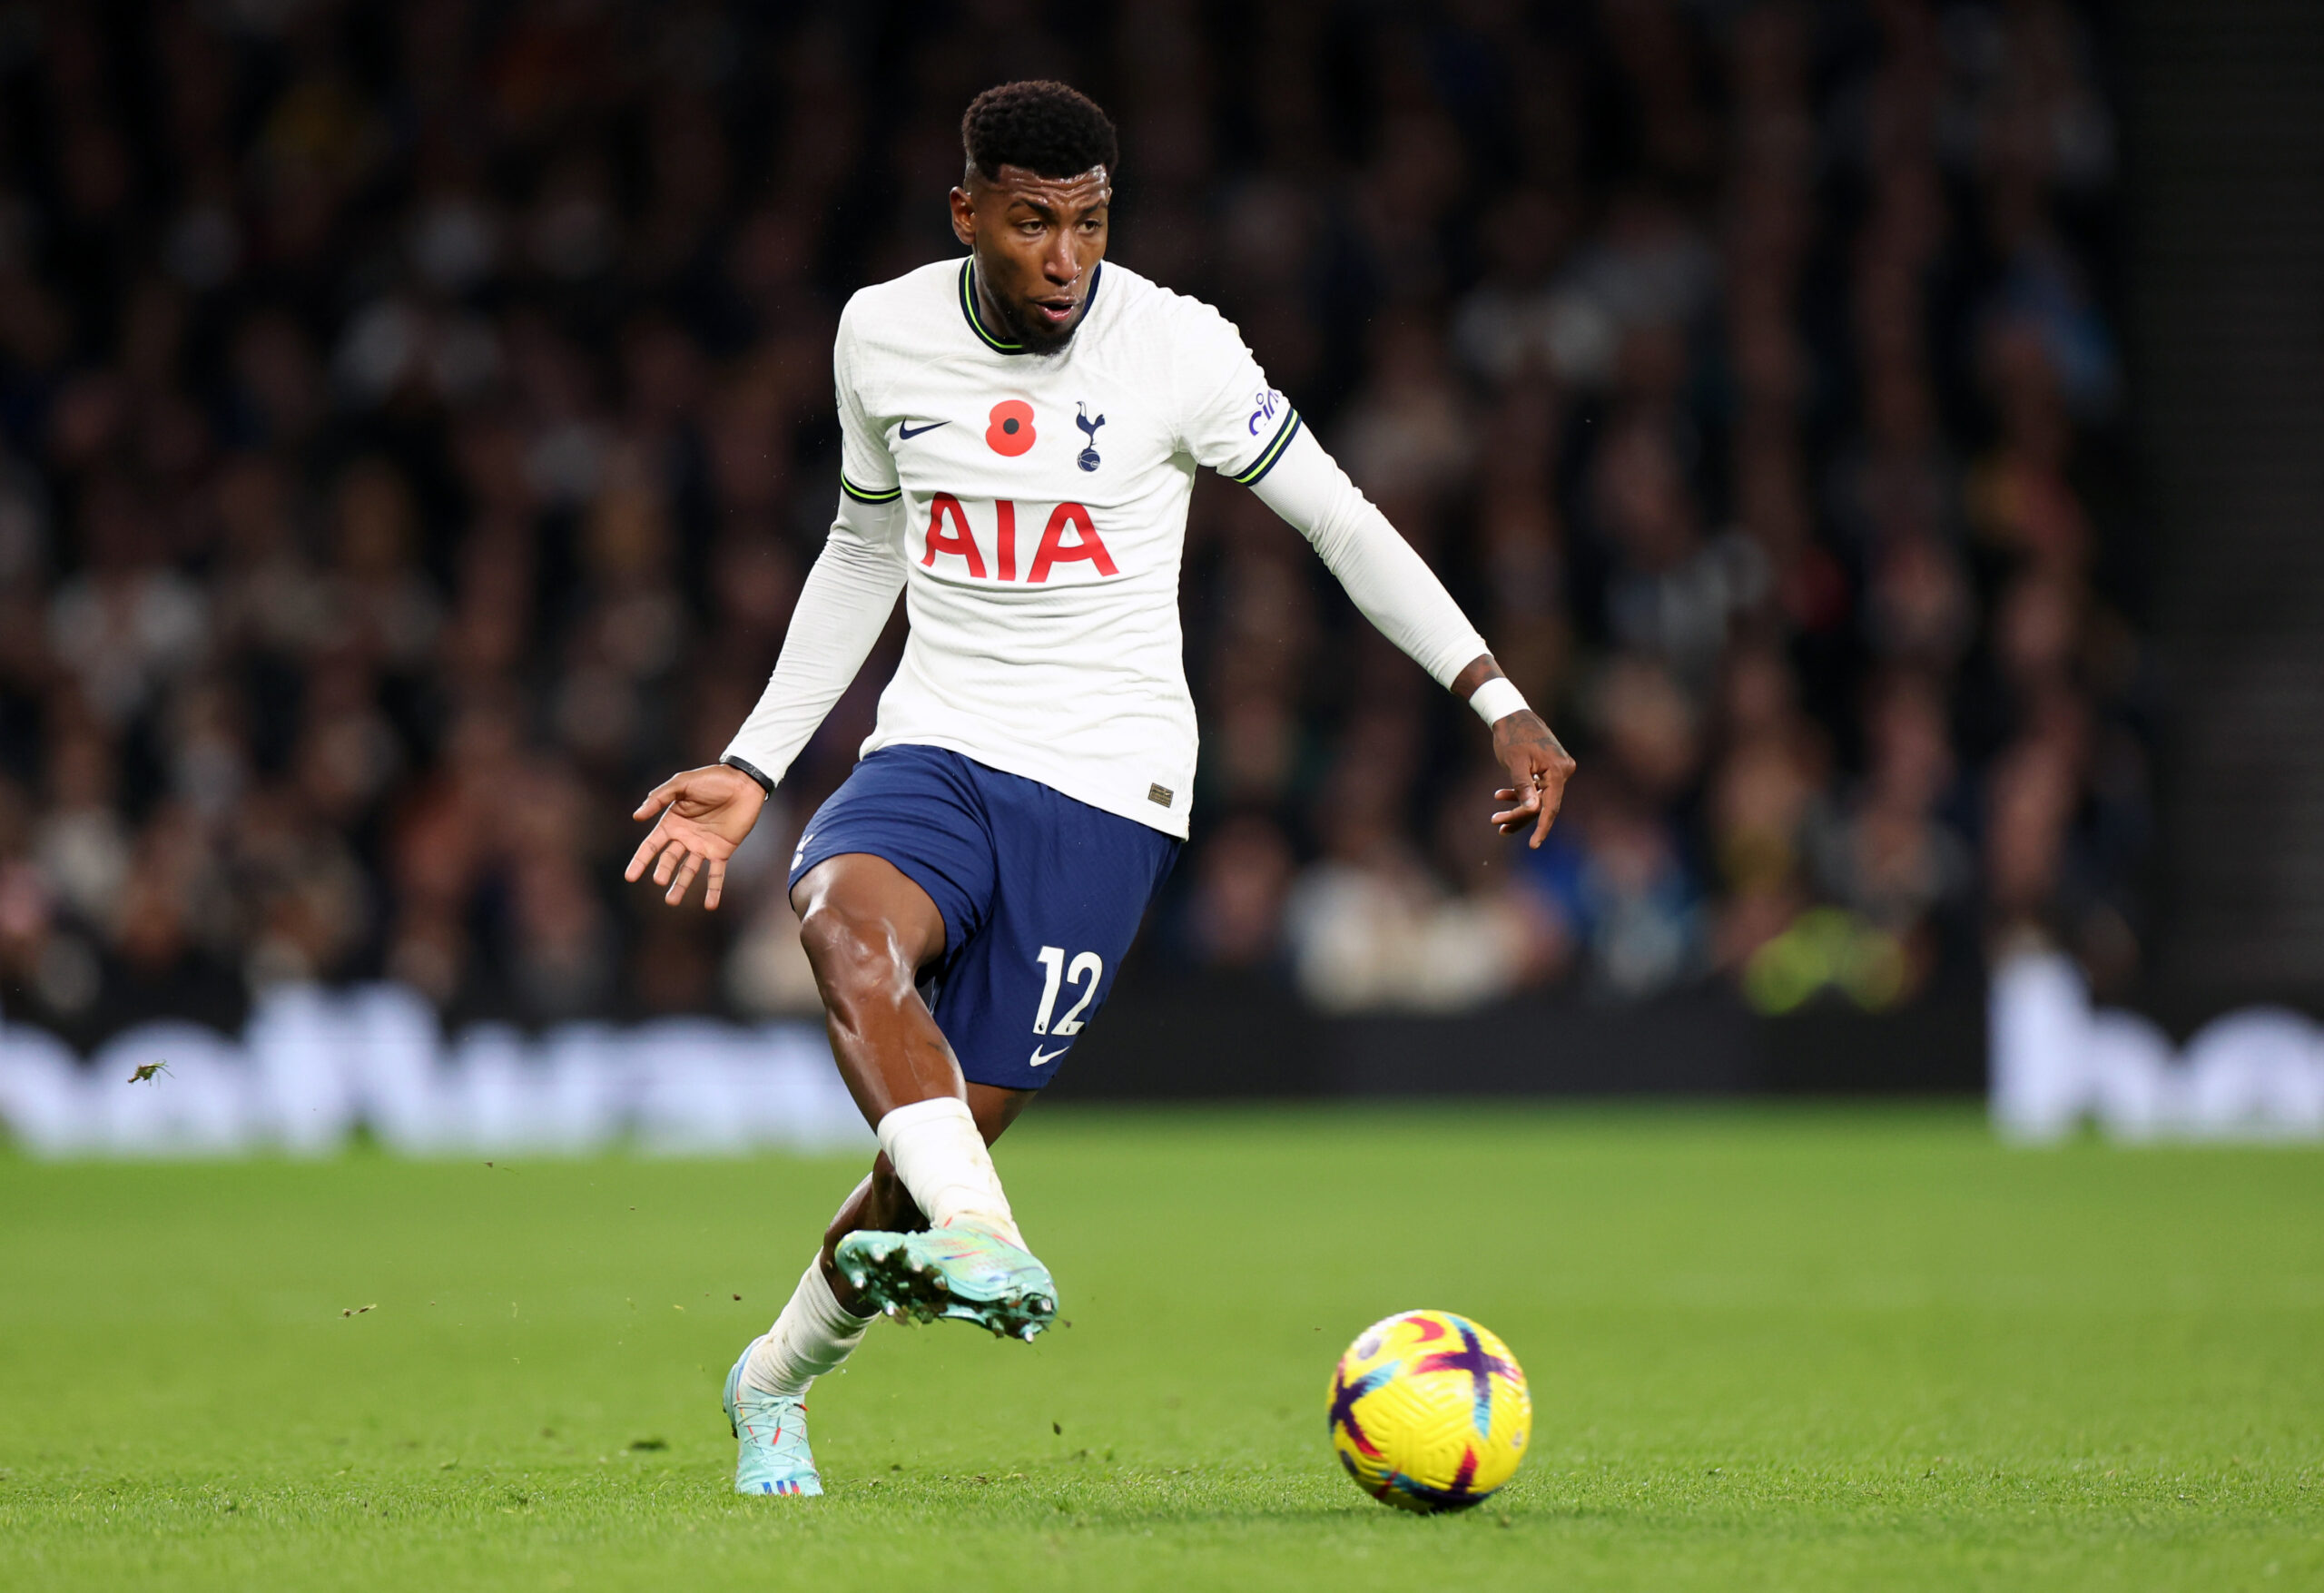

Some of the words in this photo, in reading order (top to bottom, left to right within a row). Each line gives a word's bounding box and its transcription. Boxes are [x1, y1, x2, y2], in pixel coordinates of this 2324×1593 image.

[1248, 389, 1280, 437] cin
[921, 491, 1119, 584] AIA
[1032, 945, 1103, 1036] 12
